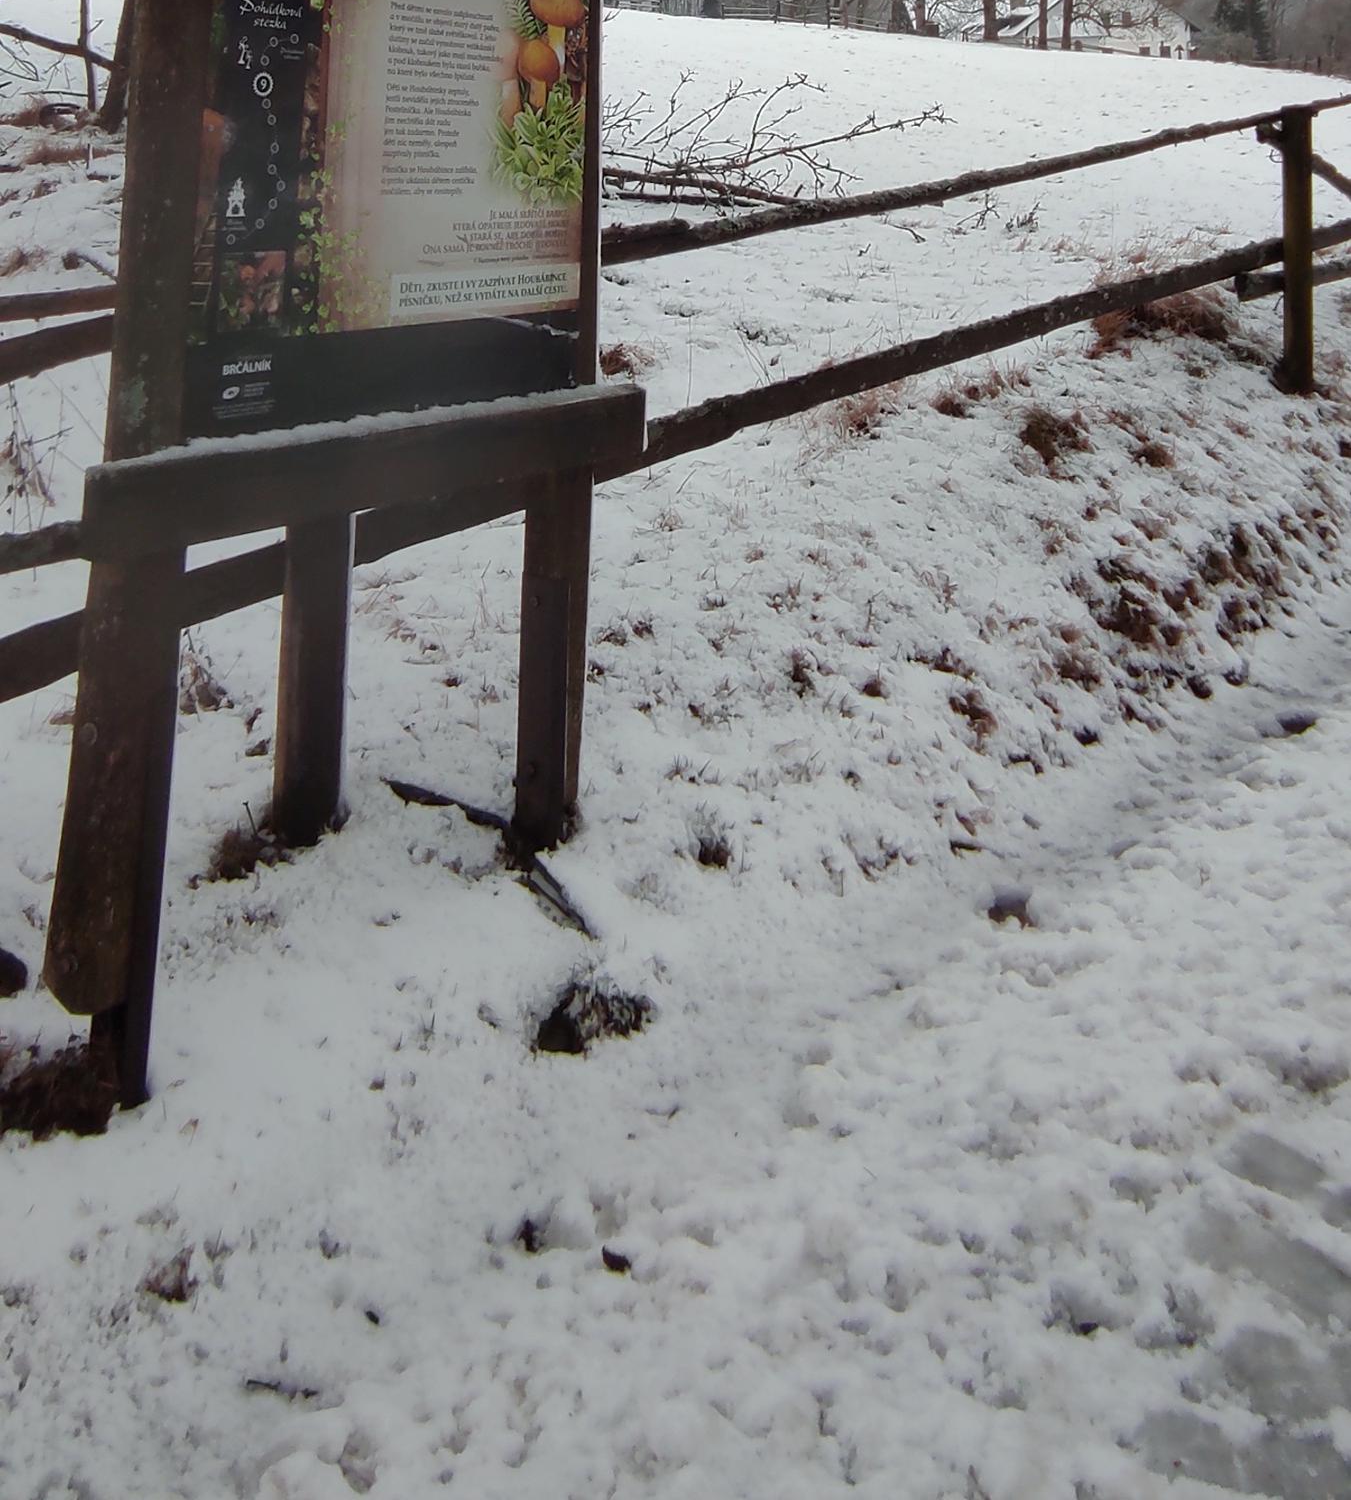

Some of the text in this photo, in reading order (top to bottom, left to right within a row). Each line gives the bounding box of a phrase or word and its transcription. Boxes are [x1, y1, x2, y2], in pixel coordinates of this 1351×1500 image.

[253, 15, 287, 29] stezka
[260, 77, 268, 91] 9
[453, 220, 476, 231] KTERÁ
[422, 244, 441, 255] ONA
[443, 244, 465, 254] SAMA
[400, 282, 425, 294] DĚTI,
[426, 280, 458, 292] ZKUSTE
[465, 280, 478, 288] VY
[478, 276, 516, 288] ZAZPÍVAT
[399, 293, 443, 307] PÍSNIČKU,
[444, 290, 462, 304] NEŽ
[463, 292, 474, 302] SE
[474, 289, 506, 300] VYDÁTE
[507, 288, 520, 298] NA
[520, 285, 543, 298] DALŠÍ
[222, 358, 272, 376] BRČÁLNÍK
